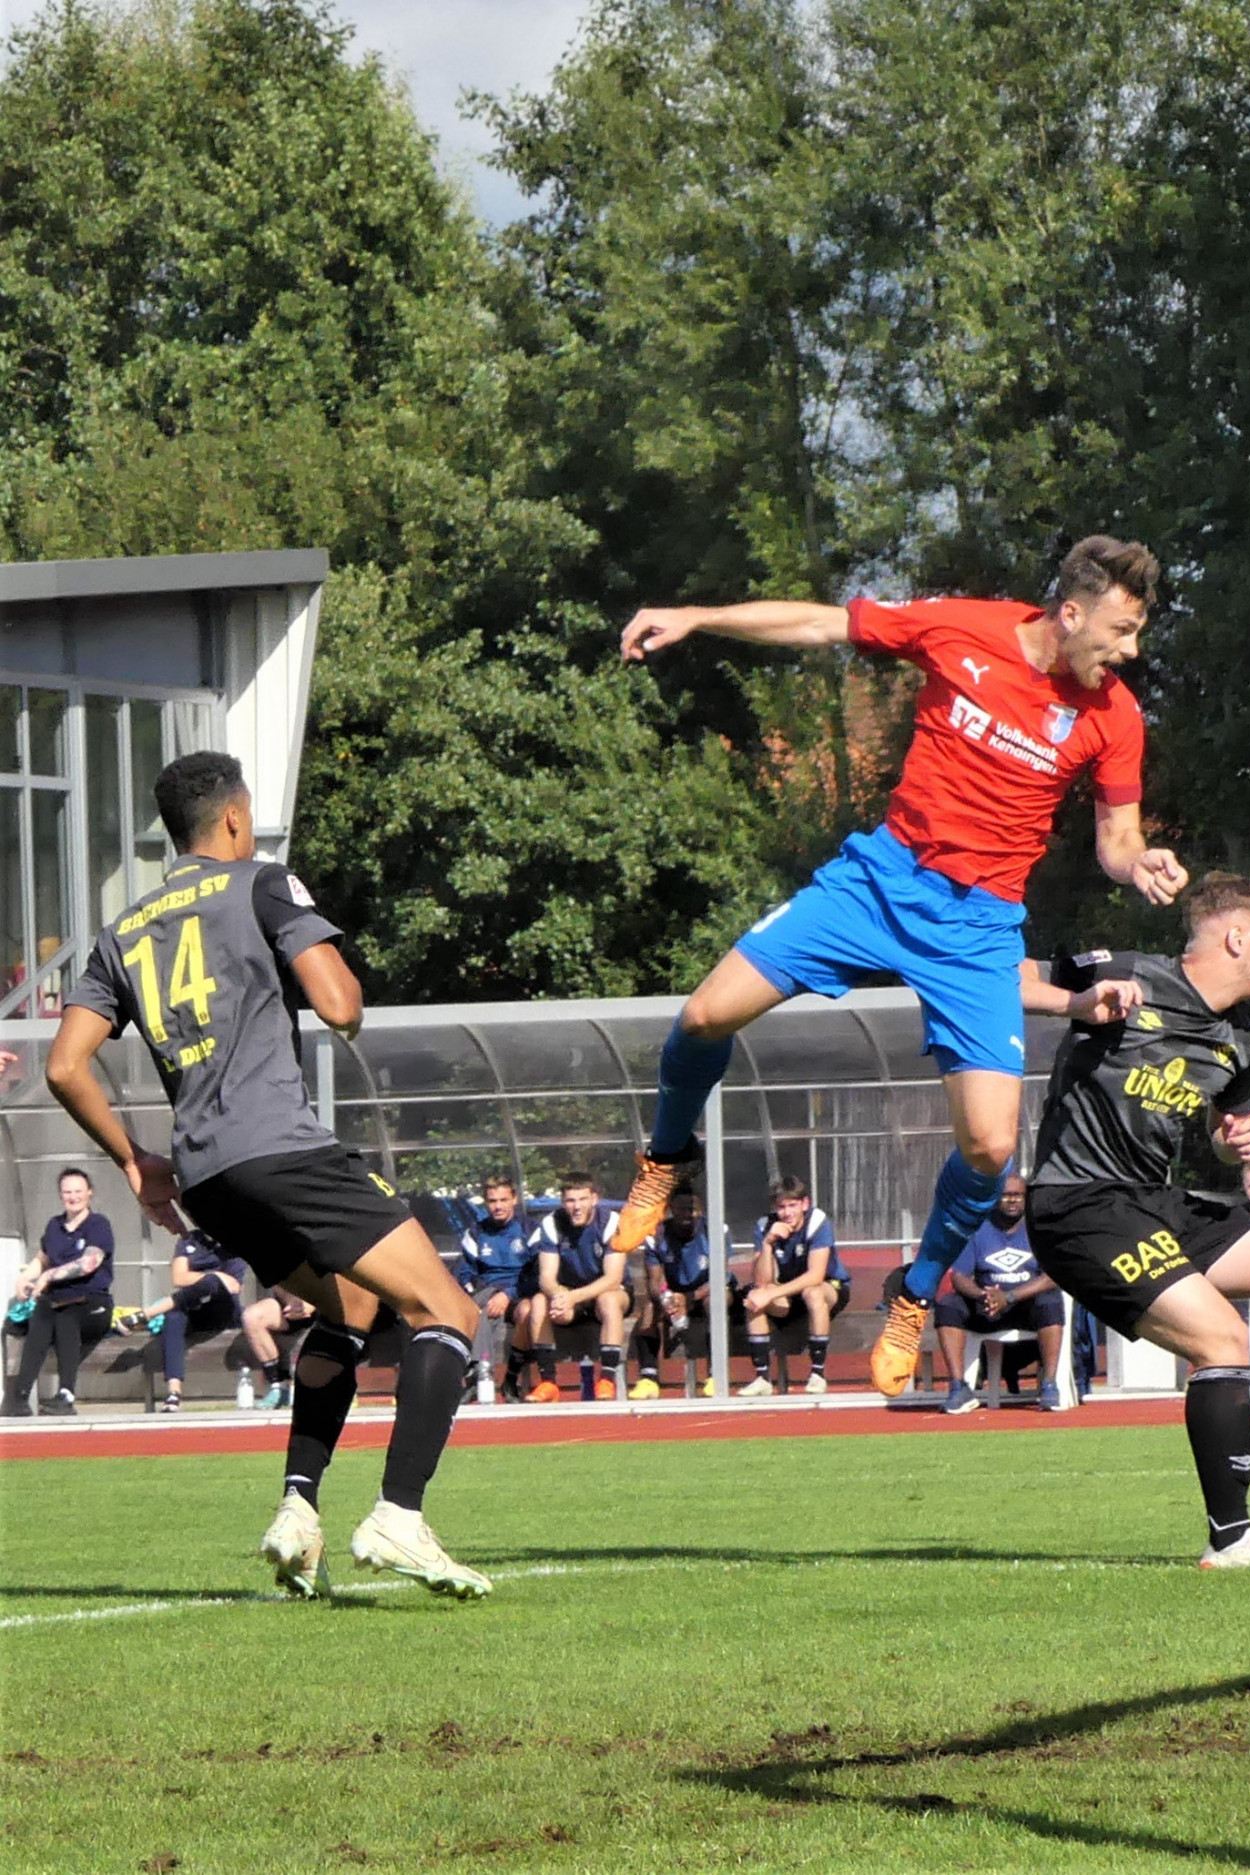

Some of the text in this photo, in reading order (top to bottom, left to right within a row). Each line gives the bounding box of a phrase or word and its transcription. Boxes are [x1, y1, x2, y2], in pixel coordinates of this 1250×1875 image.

[199, 873, 231, 898] SV
[123, 915, 217, 1043] 14
[1123, 1066, 1204, 1118] UNION
[1110, 1229, 1181, 1284] BAB
